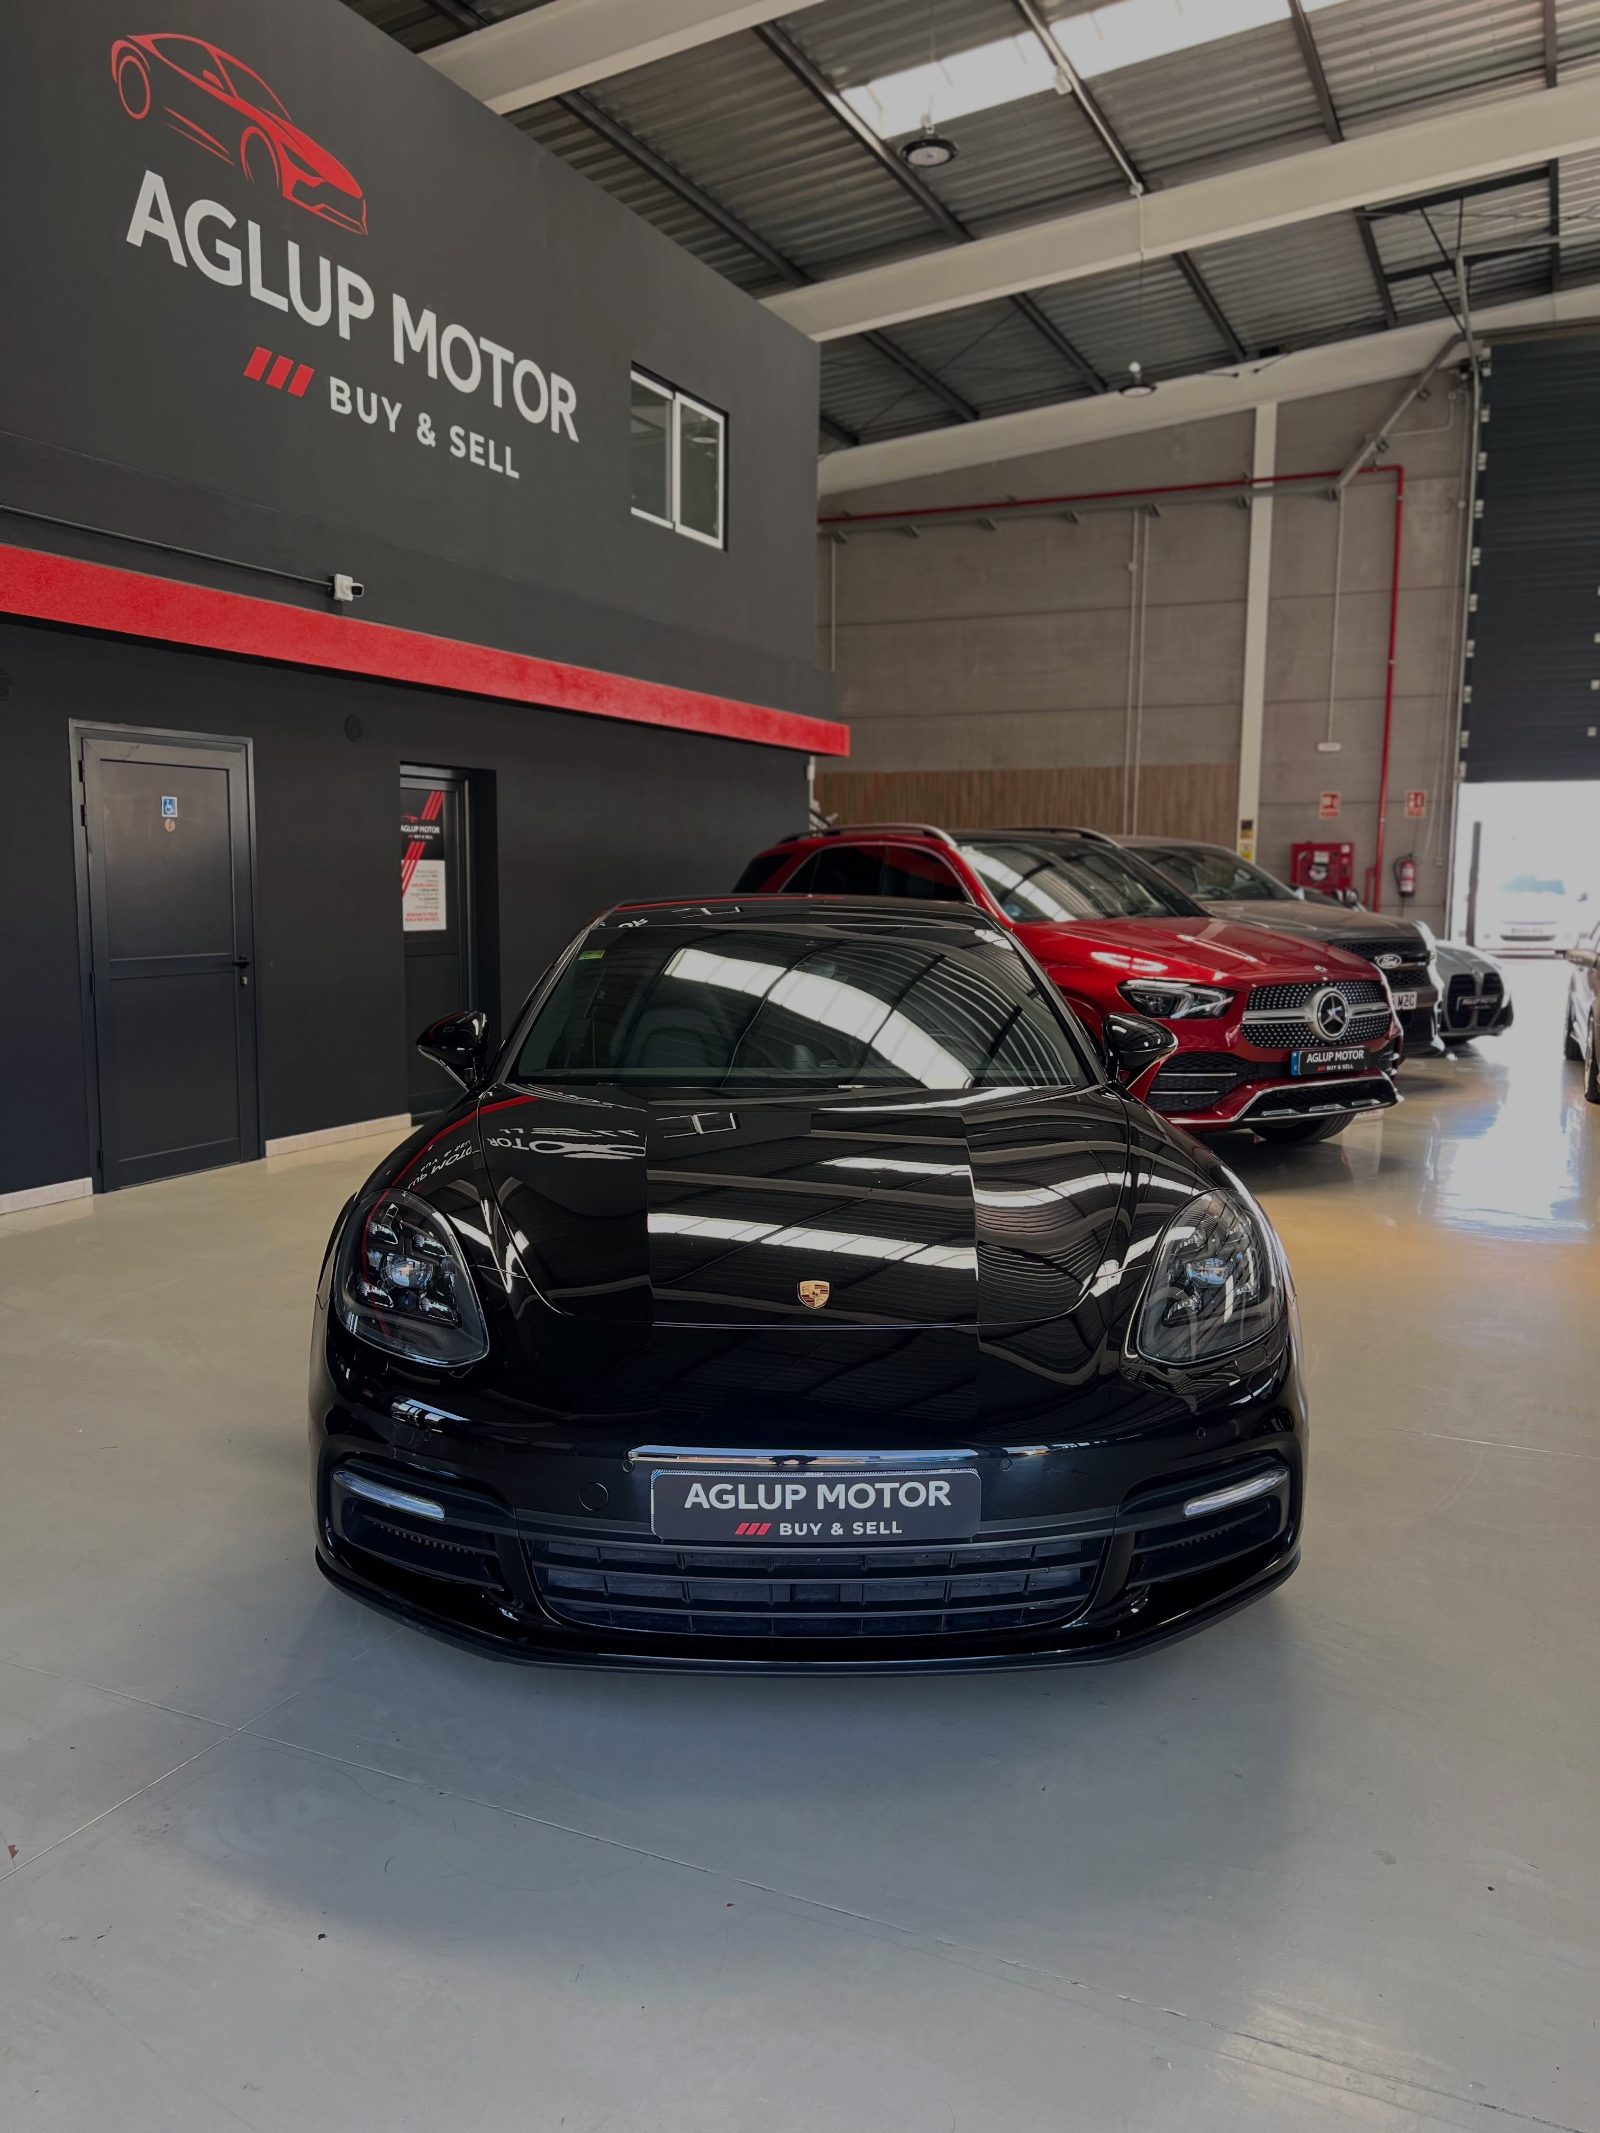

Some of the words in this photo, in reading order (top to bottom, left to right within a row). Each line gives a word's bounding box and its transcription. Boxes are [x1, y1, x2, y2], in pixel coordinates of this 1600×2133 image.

[126, 169, 375, 341] AGLUP
[392, 293, 580, 442] MOTOR
[329, 375, 403, 433] BUY
[416, 411, 437, 448] &
[450, 425, 520, 479] SELL
[1306, 1051, 1333, 1064] AGLUP
[1334, 1049, 1365, 1061] MOTOR
[684, 1482, 807, 1510] AGLUP
[817, 1480, 952, 1510] MOTOR
[779, 1522, 824, 1536] BUY
[831, 1522, 844, 1536] &
[852, 1521, 903, 1536] SELL
